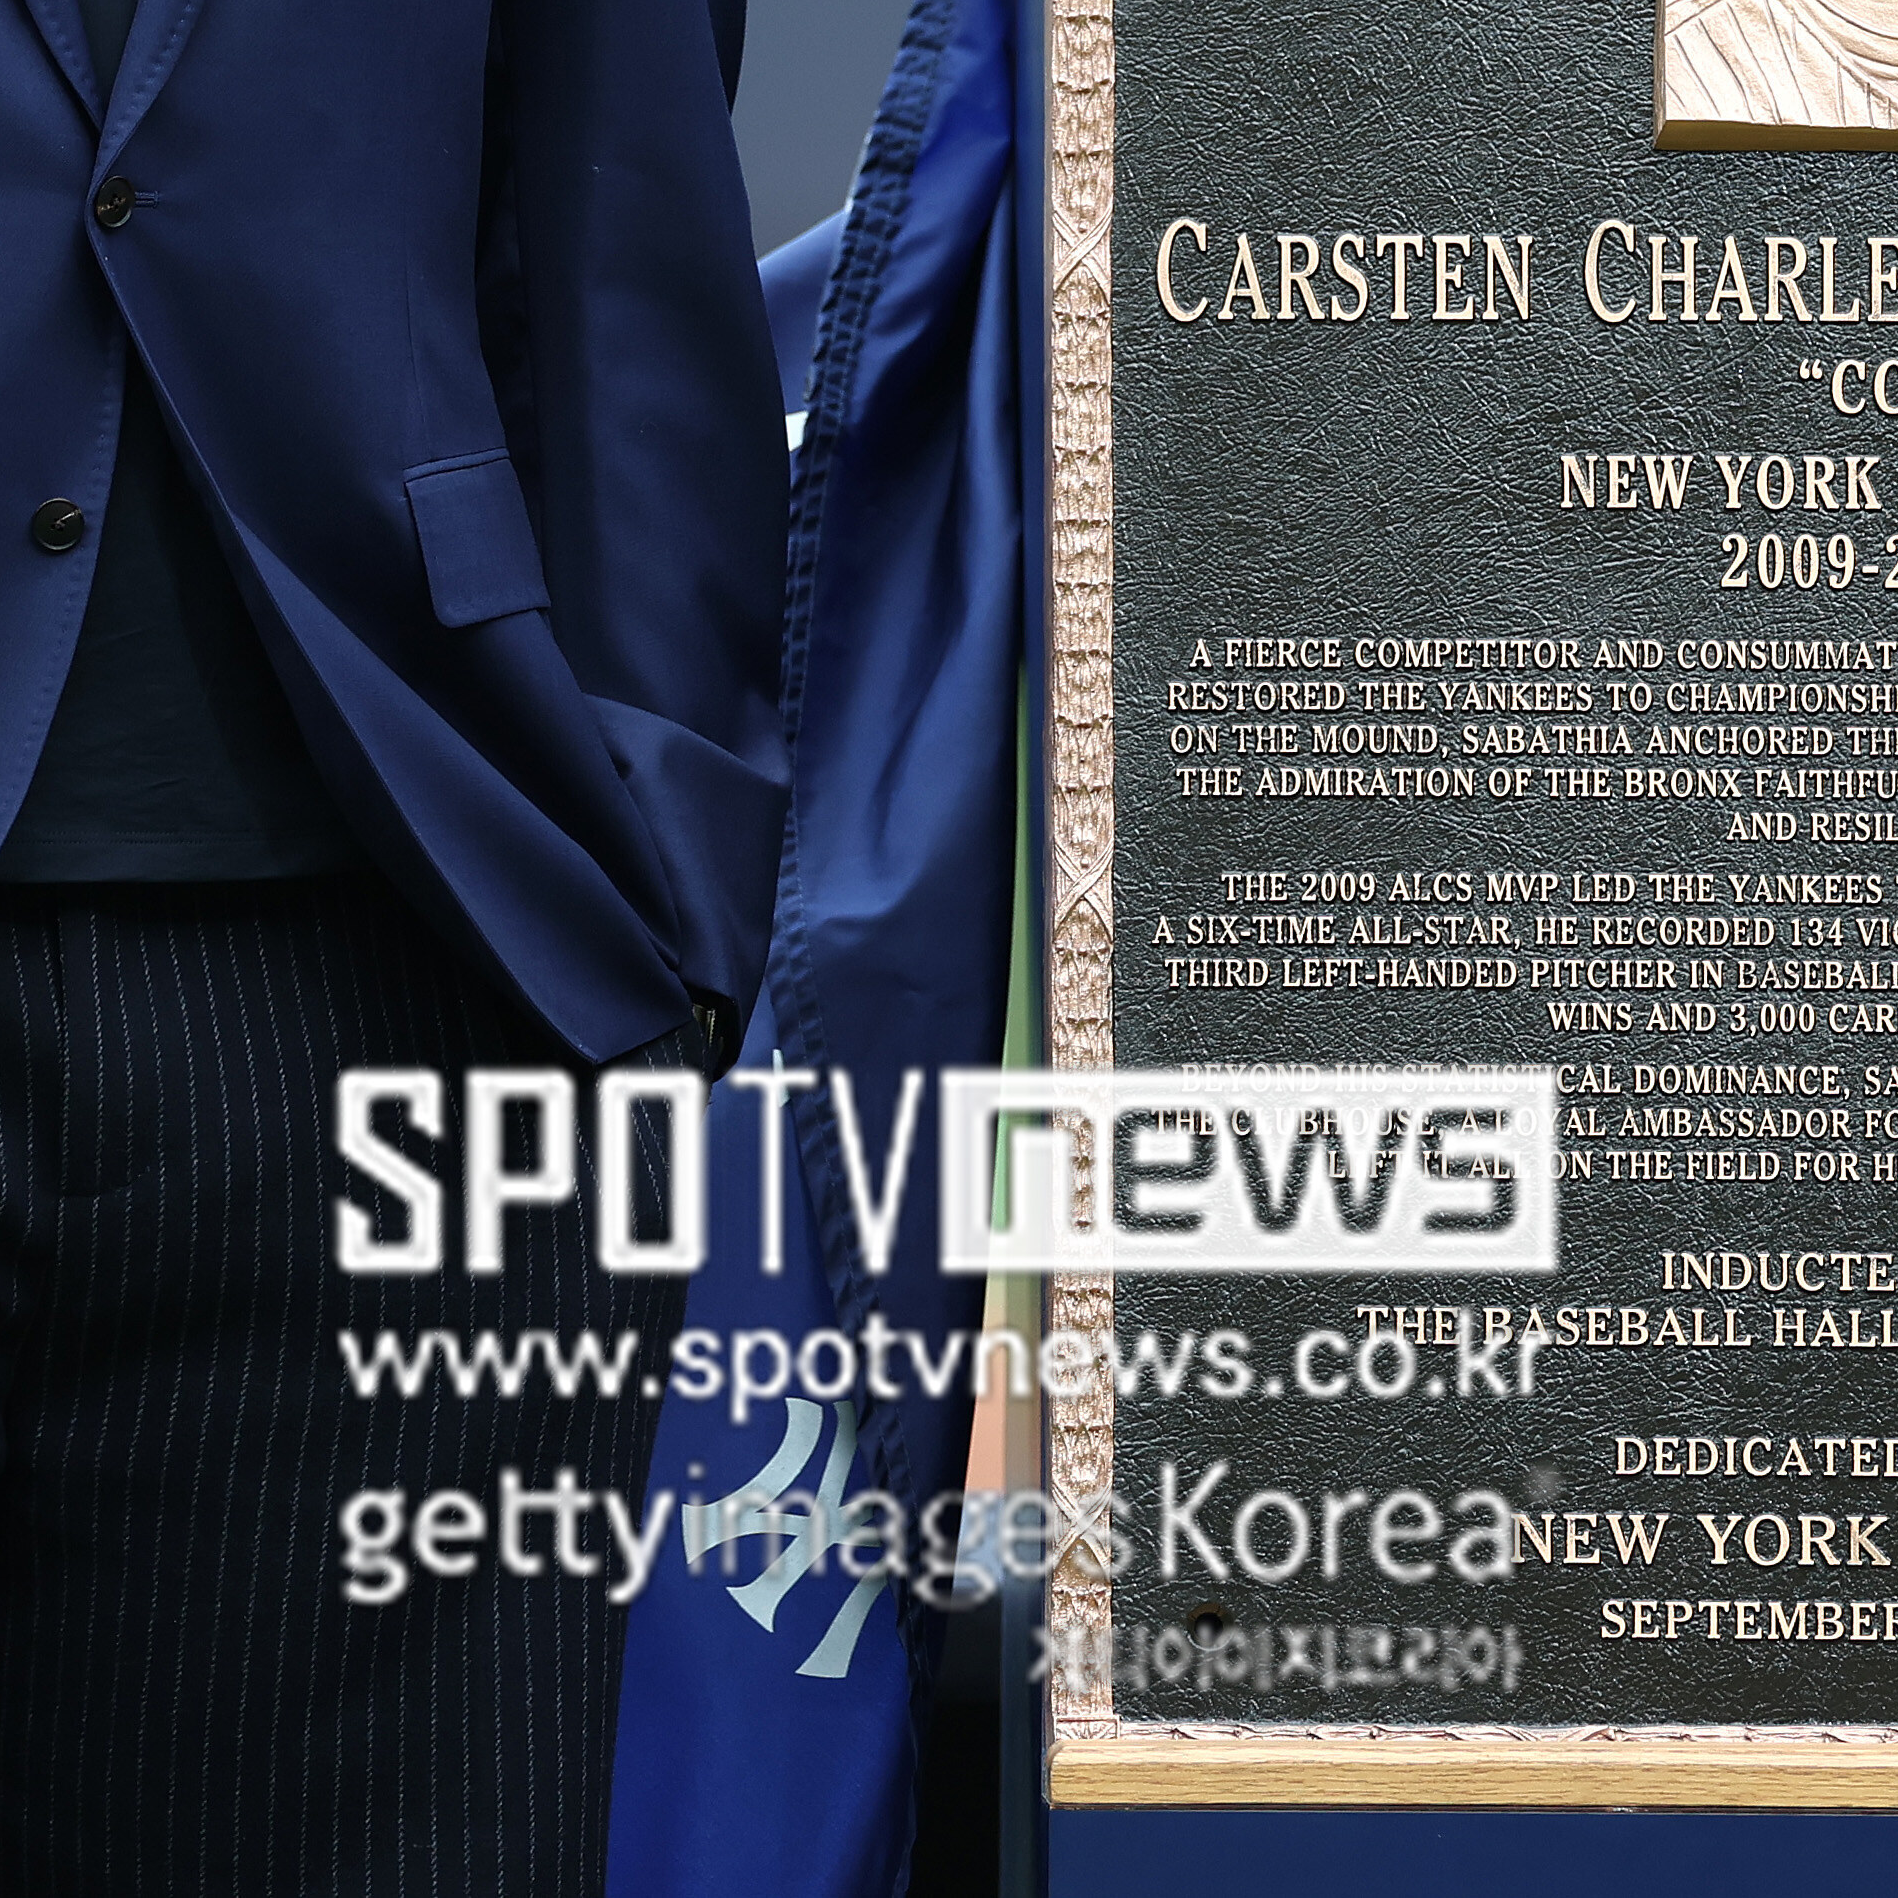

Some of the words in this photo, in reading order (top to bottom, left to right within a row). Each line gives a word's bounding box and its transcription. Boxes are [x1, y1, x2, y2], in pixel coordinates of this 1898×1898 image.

[1560, 454, 1693, 510] NEW
[1714, 454, 1883, 510] YORK
[1190, 640, 1212, 666] A
[1224, 637, 1342, 668] FIERCE
[1354, 637, 1581, 669] COMPETITOR
[1593, 639, 1664, 668] AND
[1168, 680, 1345, 711] RESTORED
[1358, 681, 1425, 711] THE
[1438, 682, 1593, 712] YANKEES
[1607, 681, 1653, 712] TO
[1170, 724, 1219, 754] ON
[1231, 724, 1299, 753] THE
[1313, 724, 1451, 759] MOUND,
[1462, 724, 1634, 754] SABATHIA
[1645, 725, 1835, 756] ANCHORED
[1176, 766, 1243, 796] THE
[1257, 767, 1476, 797] ADMIRATION
[1488, 767, 1532, 797] OF
[1544, 768, 1611, 797] THE
[1624, 768, 1742, 798] BRONX
[1726, 812, 1797, 841] AND
[1222, 872, 1288, 901] THE
[1301, 872, 1376, 902] 2009
[1388, 872, 1472, 902] ALCS
[1486, 872, 1558, 902] MVP
[1572, 872, 1639, 902] LED
[1648, 872, 1715, 903] THE
[1728, 874, 1883, 904] YANKEES
[1151, 915, 1175, 944] A
[1187, 914, 1336, 945] SIX-TIME
[1350, 915, 1521, 950] ALL-STAR,
[1536, 916, 1579, 945] HE
[1592, 916, 1775, 946] RECORDED
[1790, 917, 1843, 947] 134
[1164, 957, 1269, 987] THIRD
[1282, 958, 1517, 988] LEFT-HANDED
[1531, 959, 1678, 988] PITCHER
[1689, 959, 1724, 988] IN
[1548, 1002, 1633, 1032] WINS
[1645, 1002, 1717, 1031] AND
[1730, 1002, 1815, 1036] 3,000
[1634, 1064, 1850, 1099] DOMINANCE,
[1150, 1106, 1219, 1137] THE
[1460, 1106, 1482, 1136] A
[1618, 1107, 1853, 1138] AMBASSADOR
[1548, 1149, 1593, 1180] ON
[1605, 1150, 1673, 1180] THE
[1686, 1150, 1781, 1180] FIELD
[1793, 1151, 1860, 1181] FOR
[1356, 1305, 1463, 1345] THE
[1482, 1307, 1754, 1346] BASEBALL
[1510, 1512, 1670, 1565] NEW
[1696, 1513, 1892, 1566] YORK
